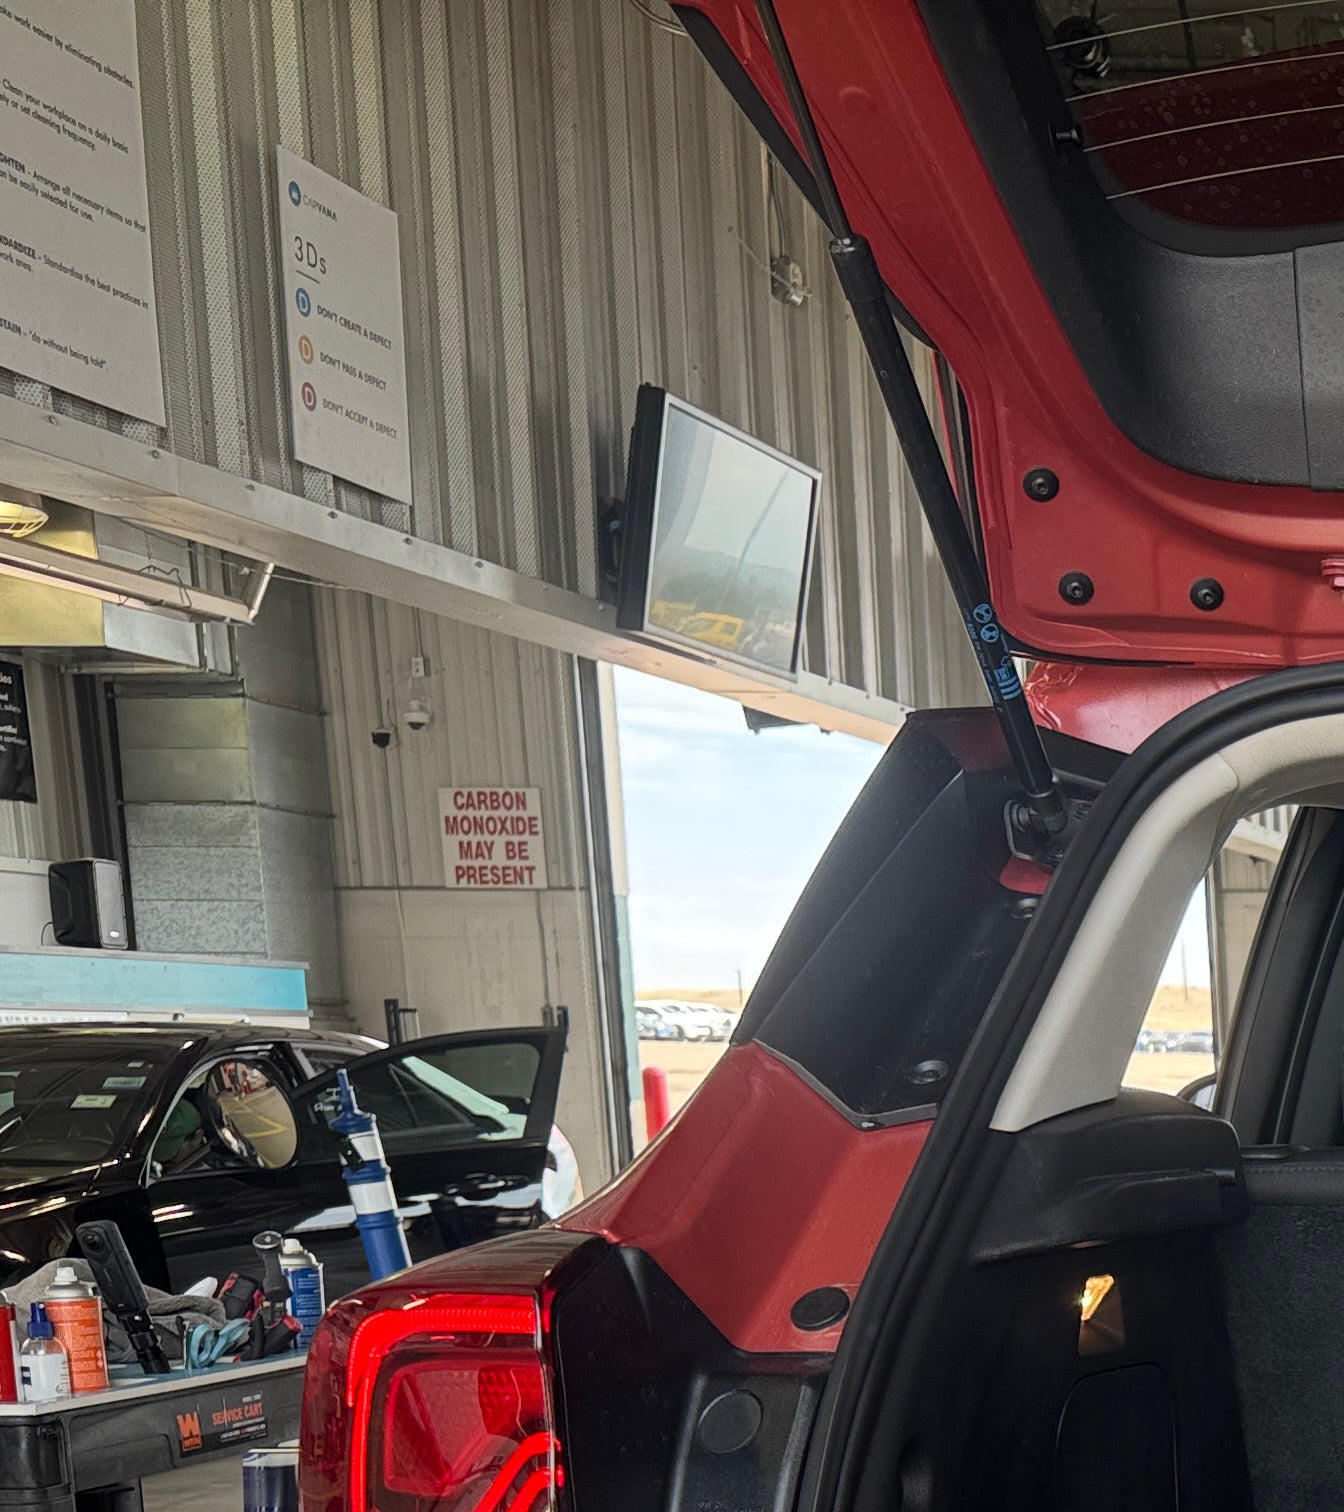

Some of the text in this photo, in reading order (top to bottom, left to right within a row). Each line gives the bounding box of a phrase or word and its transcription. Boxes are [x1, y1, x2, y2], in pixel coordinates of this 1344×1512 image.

[14, 14, 30, 29] work
[32, 25, 53, 42] easier
[54, 34, 63, 50] by
[64, 43, 102, 72] eliminating
[3, 79, 23, 97] Clean
[25, 93, 40, 107] your
[42, 102, 76, 126] workplace
[78, 121, 87, 133] on
[95, 129, 110, 145] daily
[112, 136, 128, 153] basis
[11, 100, 18, 110] or
[20, 104, 30, 115] set
[32, 110, 61, 134] cleaning
[9, 172, 17, 184] be
[20, 179, 38, 196] easily
[40, 190, 67, 209] selected
[69, 201, 78, 214] for
[33, 170, 60, 191] Arrange
[62, 185, 70, 196] all
[72, 192, 104, 214] necessary
[106, 206, 123, 222] items
[125, 217, 132, 226] so
[133, 219, 146, 233] that
[302, 194, 338, 222] CARVANA
[294, 235, 326, 275] 3Ds
[85, 273, 95, 286] the
[97, 278, 110, 292] best
[113, 288, 141, 305] practices
[142, 300, 148, 310] in
[317, 305, 392, 350] DON'T CREATE A DEFECT
[43, 339, 67, 354] without
[69, 346, 89, 365] being
[320, 352, 387, 391] DON'T PASS A DEFECT
[323, 398, 397, 438] DON'T ACCEPT A DEFECT
[453, 790, 527, 811] CARBON
[444, 815, 540, 836] MONOXIDE
[458, 840, 529, 860] MAY BE
[455, 865, 536, 885] PRESENT
[212, 1407, 243, 1426] SERVICE
[244, 1402, 263, 1418] CART
